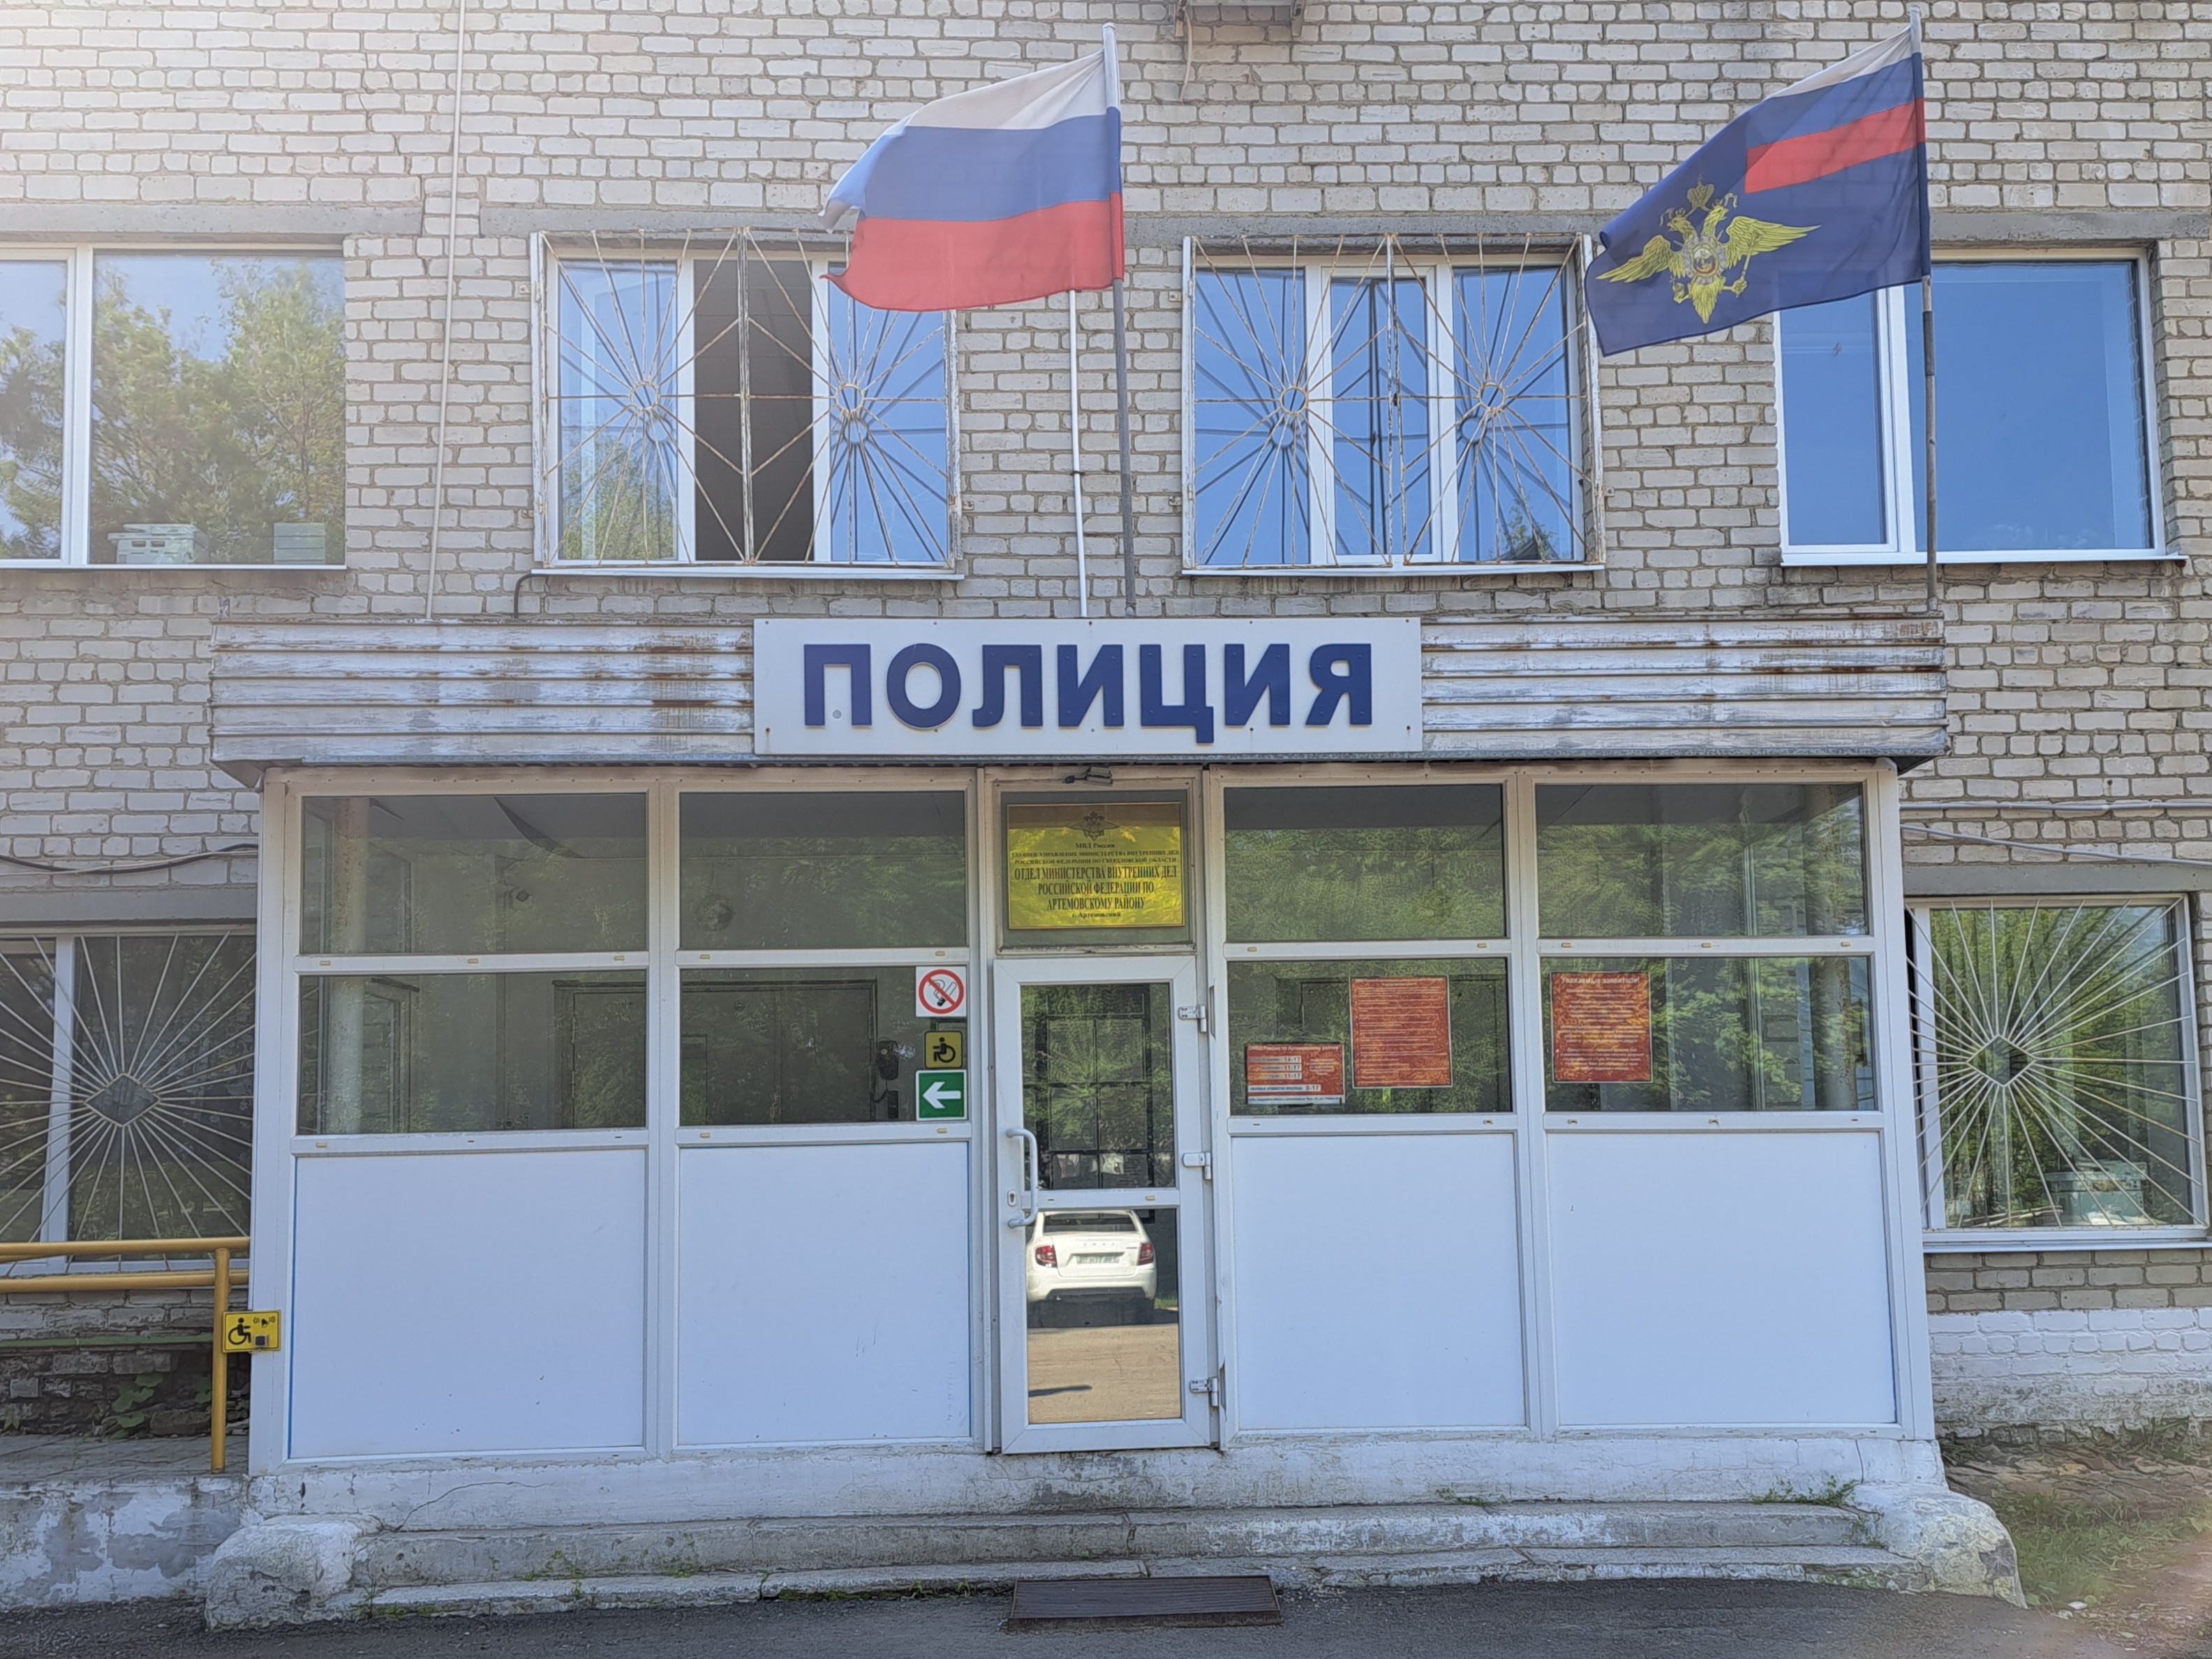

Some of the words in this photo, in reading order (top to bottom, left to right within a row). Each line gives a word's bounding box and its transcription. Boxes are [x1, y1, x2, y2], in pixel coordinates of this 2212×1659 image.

[803, 642, 1372, 745] ПОЛИЦИЯ
[1014, 868, 1041, 881] ОТДЕЛ
[1041, 867, 1106, 880] МИНИСТЕРСТВА
[1107, 865, 1159, 879] ВНУТРЕННИХ
[1161, 865, 1178, 879] ДЕЛ
[1038, 879, 1092, 895] РОССИЙСКОЙ
[1094, 881, 1141, 896] ФЕДЕРАЦИИ
[1143, 881, 1155, 893] ПО
[1048, 897, 1112, 911] АРТЕМОВСКОМУ
[1114, 894, 1146, 909] РАЙОНУ
[1078, 911, 1121, 919] Артемовский
